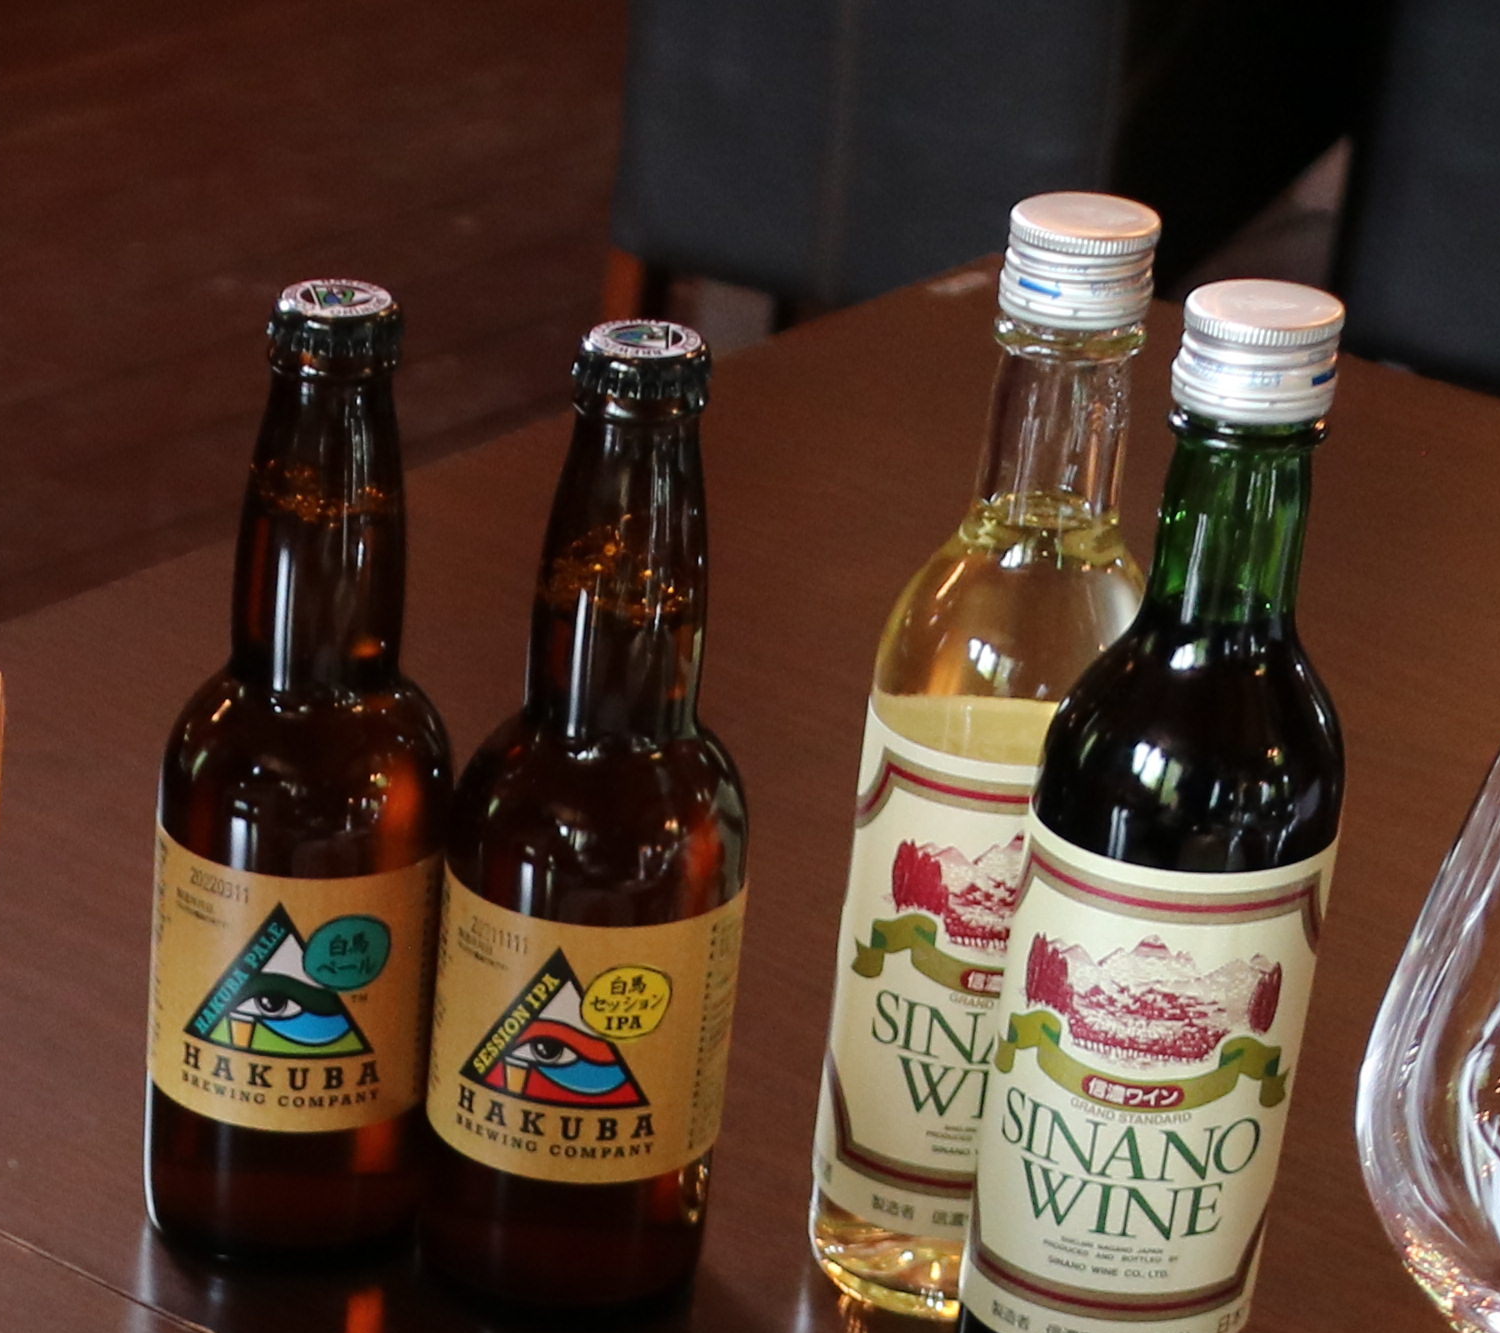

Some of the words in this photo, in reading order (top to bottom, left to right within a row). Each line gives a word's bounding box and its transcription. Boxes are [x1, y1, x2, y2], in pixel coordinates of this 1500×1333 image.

[329, 931, 370, 957] 白馬
[194, 970, 249, 1034] HAKUBA
[248, 921, 286, 969] PALE
[610, 976, 647, 996] 白馬
[590, 992, 665, 1012] セッション
[473, 1009, 530, 1075] SESSION
[529, 973, 561, 1013] IPA
[605, 1015, 642, 1031] IPA
[183, 1042, 380, 1091] HAKUBA
[182, 1071, 265, 1105] BREWING
[277, 1088, 380, 1108] COMPANY
[1087, 1079, 1180, 1106] 信濃ワイン
[458, 1084, 656, 1142] HAKUBA
[1070, 1096, 1115, 1120] GRAND
[1117, 1111, 1193, 1125] STANDARD
[456, 1114, 538, 1153] BREWING
[549, 1142, 656, 1159] COMPANY
[1001, 1086, 1261, 1182] SINANO
[1021, 1156, 1223, 1241] WINE
[1048, 1255, 1086, 1271] SINANO
[1091, 1265, 1118, 1276] WINE
[991, 1300, 1030, 1331] 製造者
